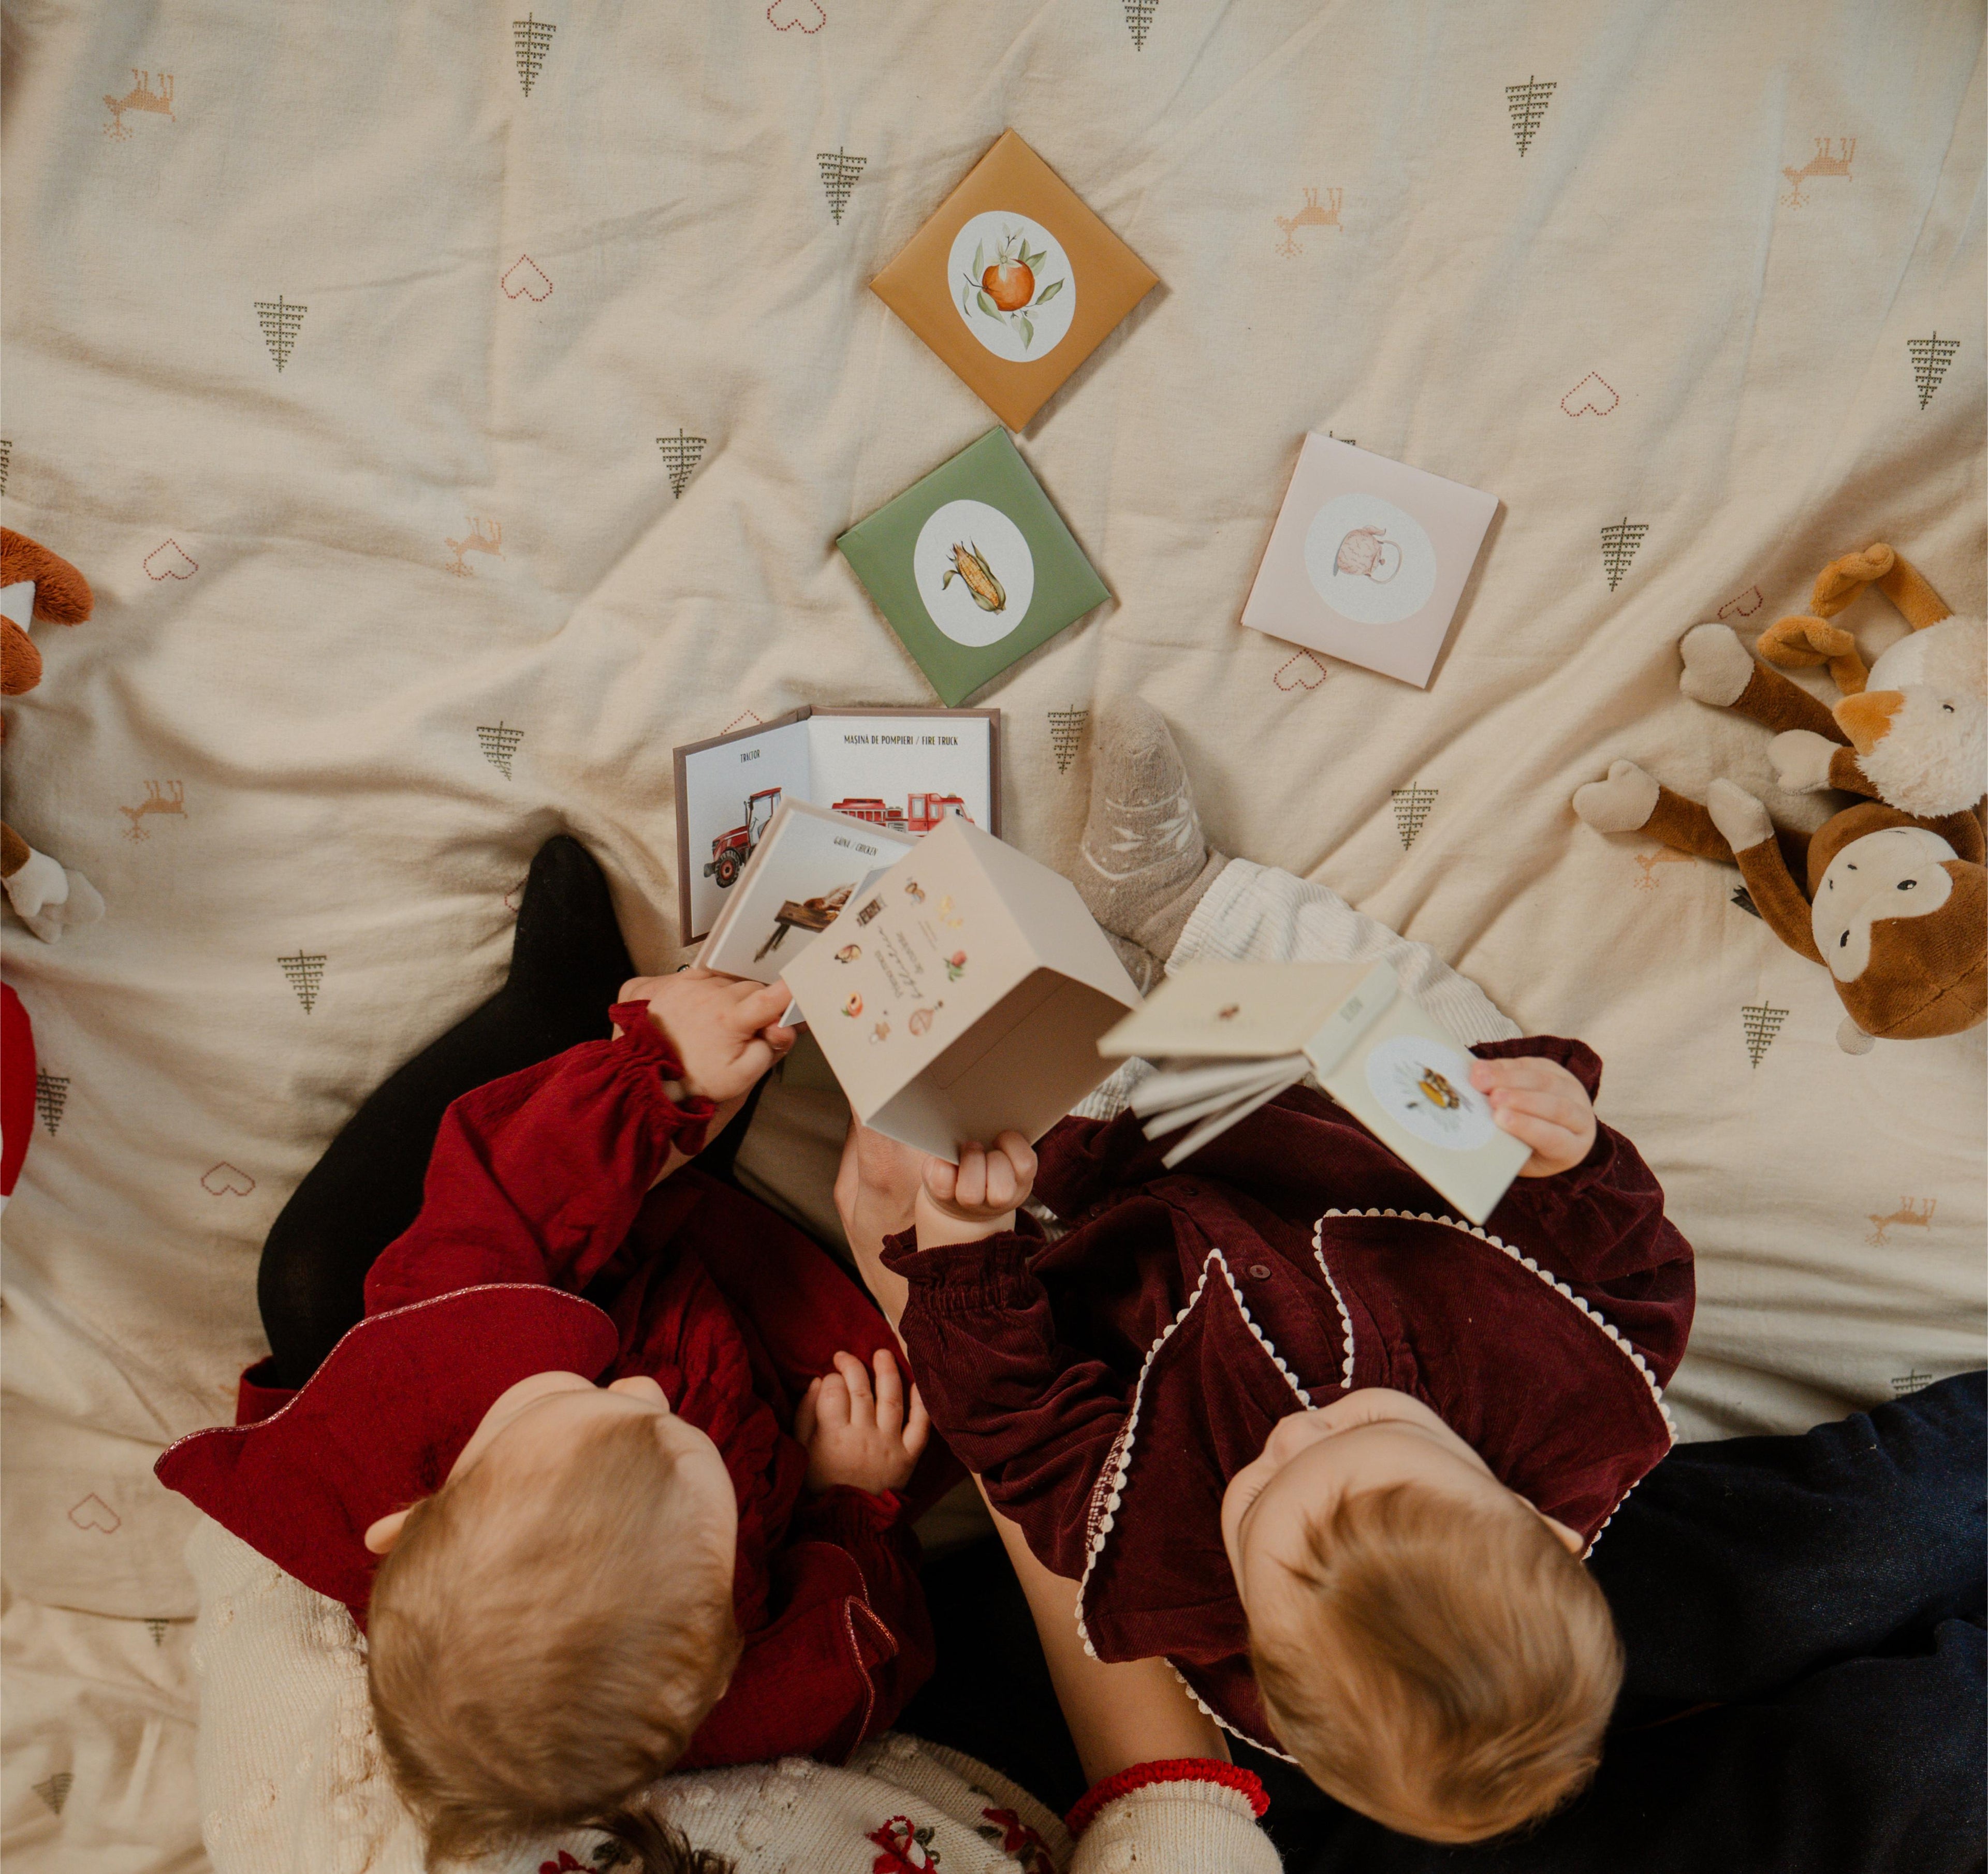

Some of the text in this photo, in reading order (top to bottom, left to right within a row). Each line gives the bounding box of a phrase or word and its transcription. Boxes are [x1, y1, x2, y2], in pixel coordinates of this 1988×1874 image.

[872, 735, 879, 744] DE
[881, 735, 913, 745] POMPIERI
[916, 736, 920, 745] /
[922, 736, 935, 745] FIRE
[938, 736, 958, 746] TRUCK
[740, 749, 761, 764] TRACTOR
[855, 843, 878, 856] CHICKEN
